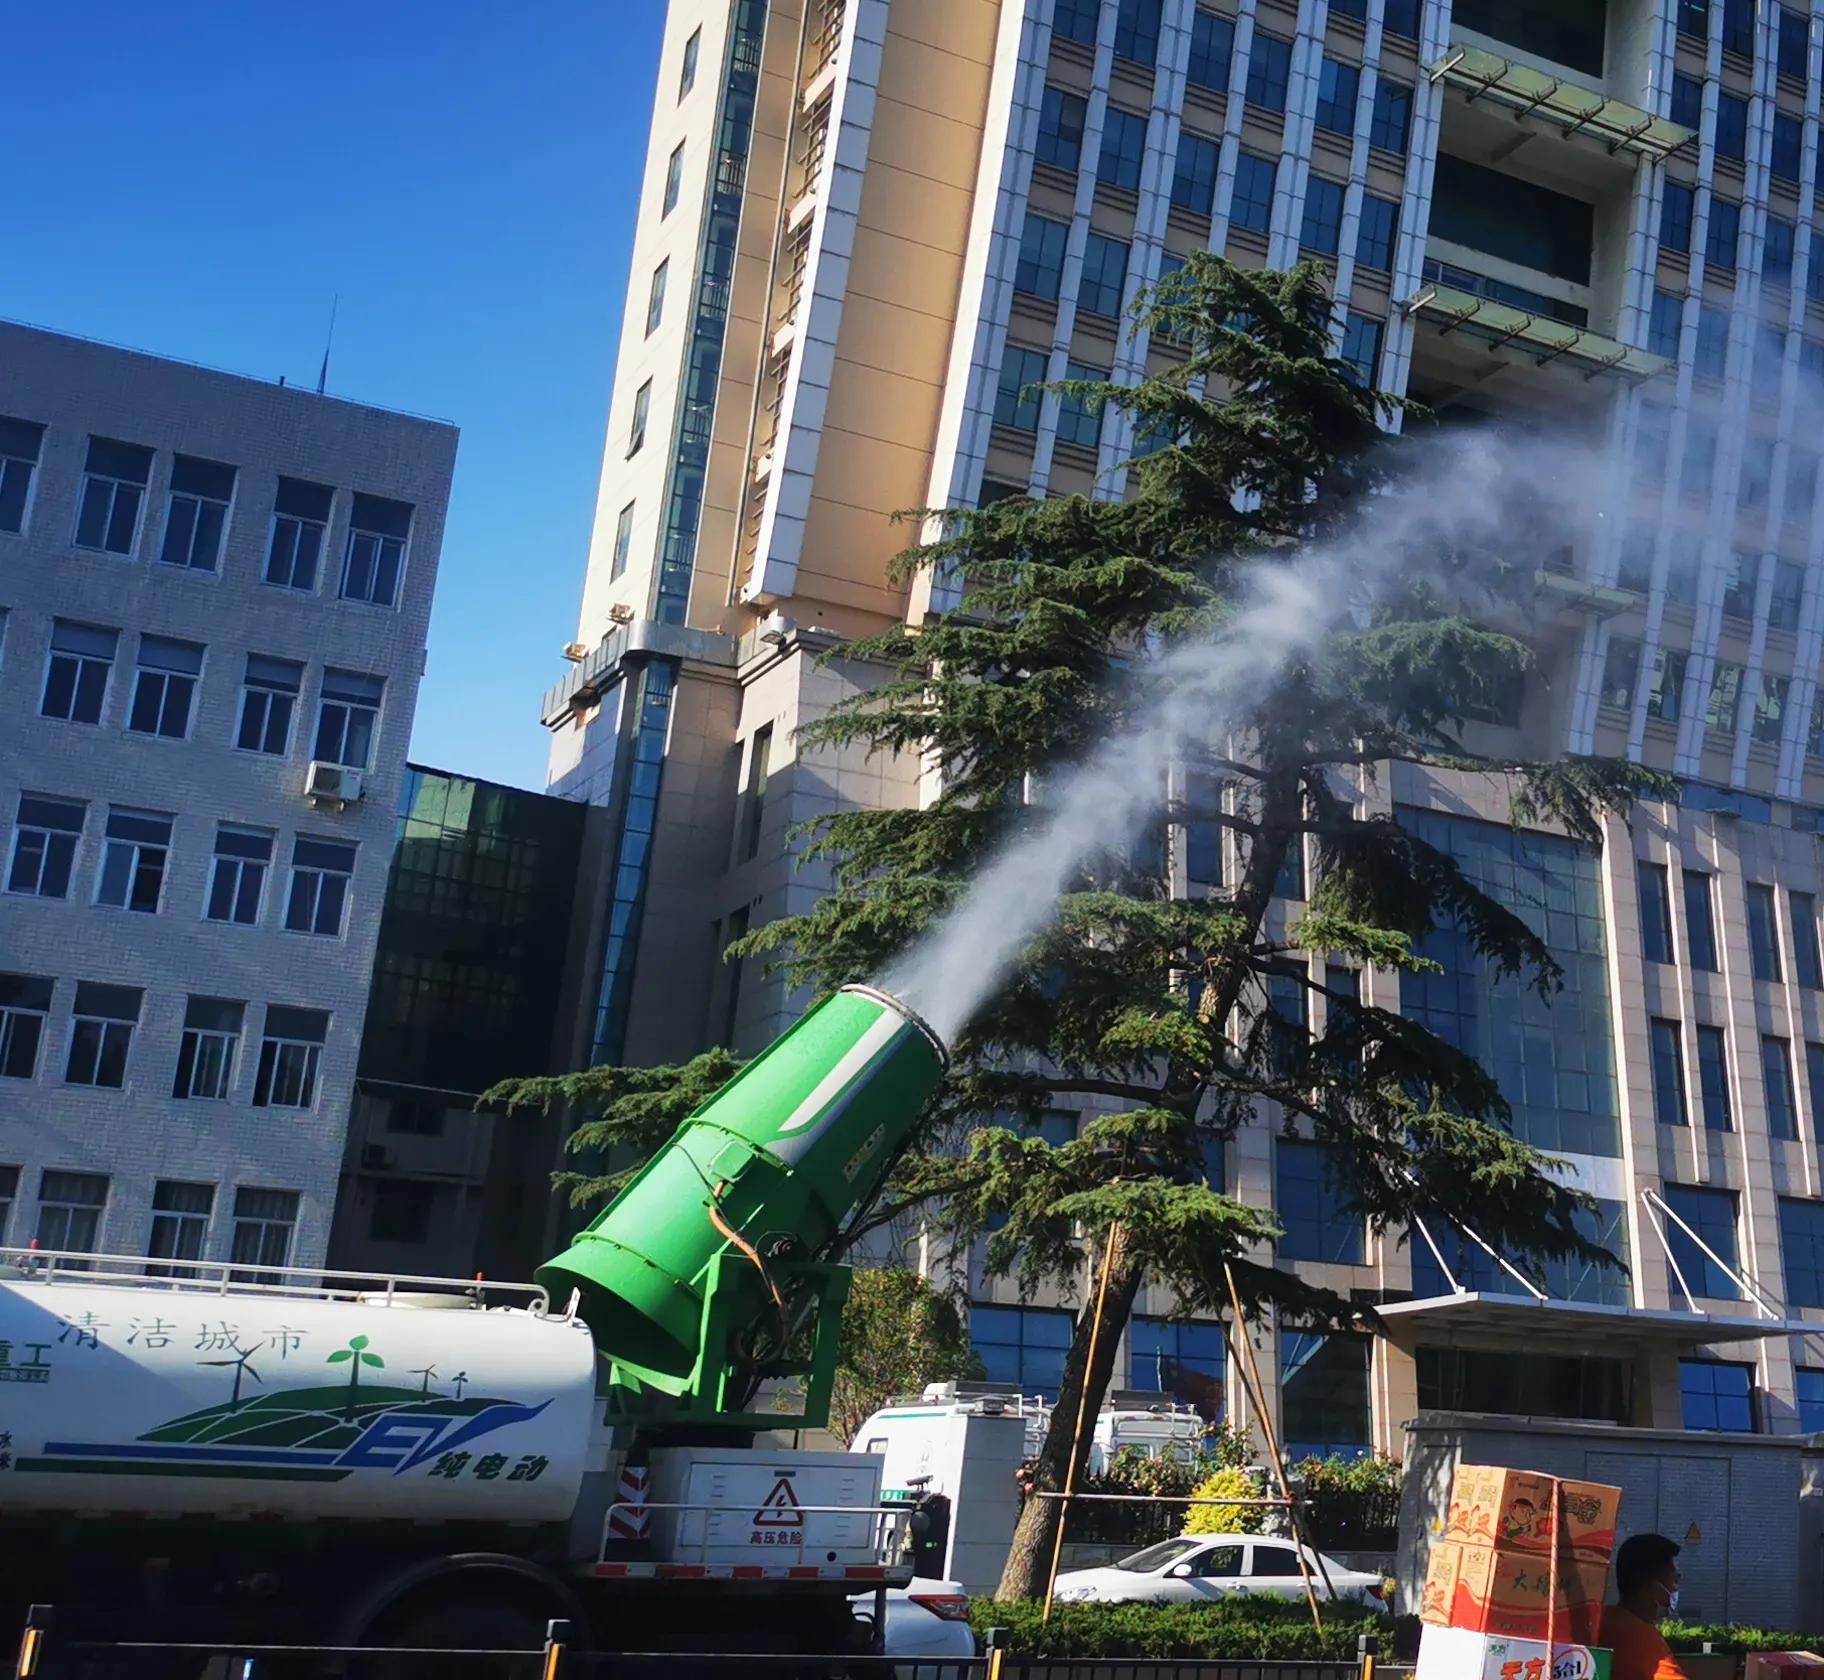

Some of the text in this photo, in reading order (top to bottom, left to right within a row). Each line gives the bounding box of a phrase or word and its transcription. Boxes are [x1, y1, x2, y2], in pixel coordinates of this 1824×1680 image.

[57, 1310, 310, 1360] 清洁城市
[333, 1398, 556, 1477] EV
[426, 1450, 550, 1482] 纯电动
[749, 1530, 802, 1545] 高压危险
